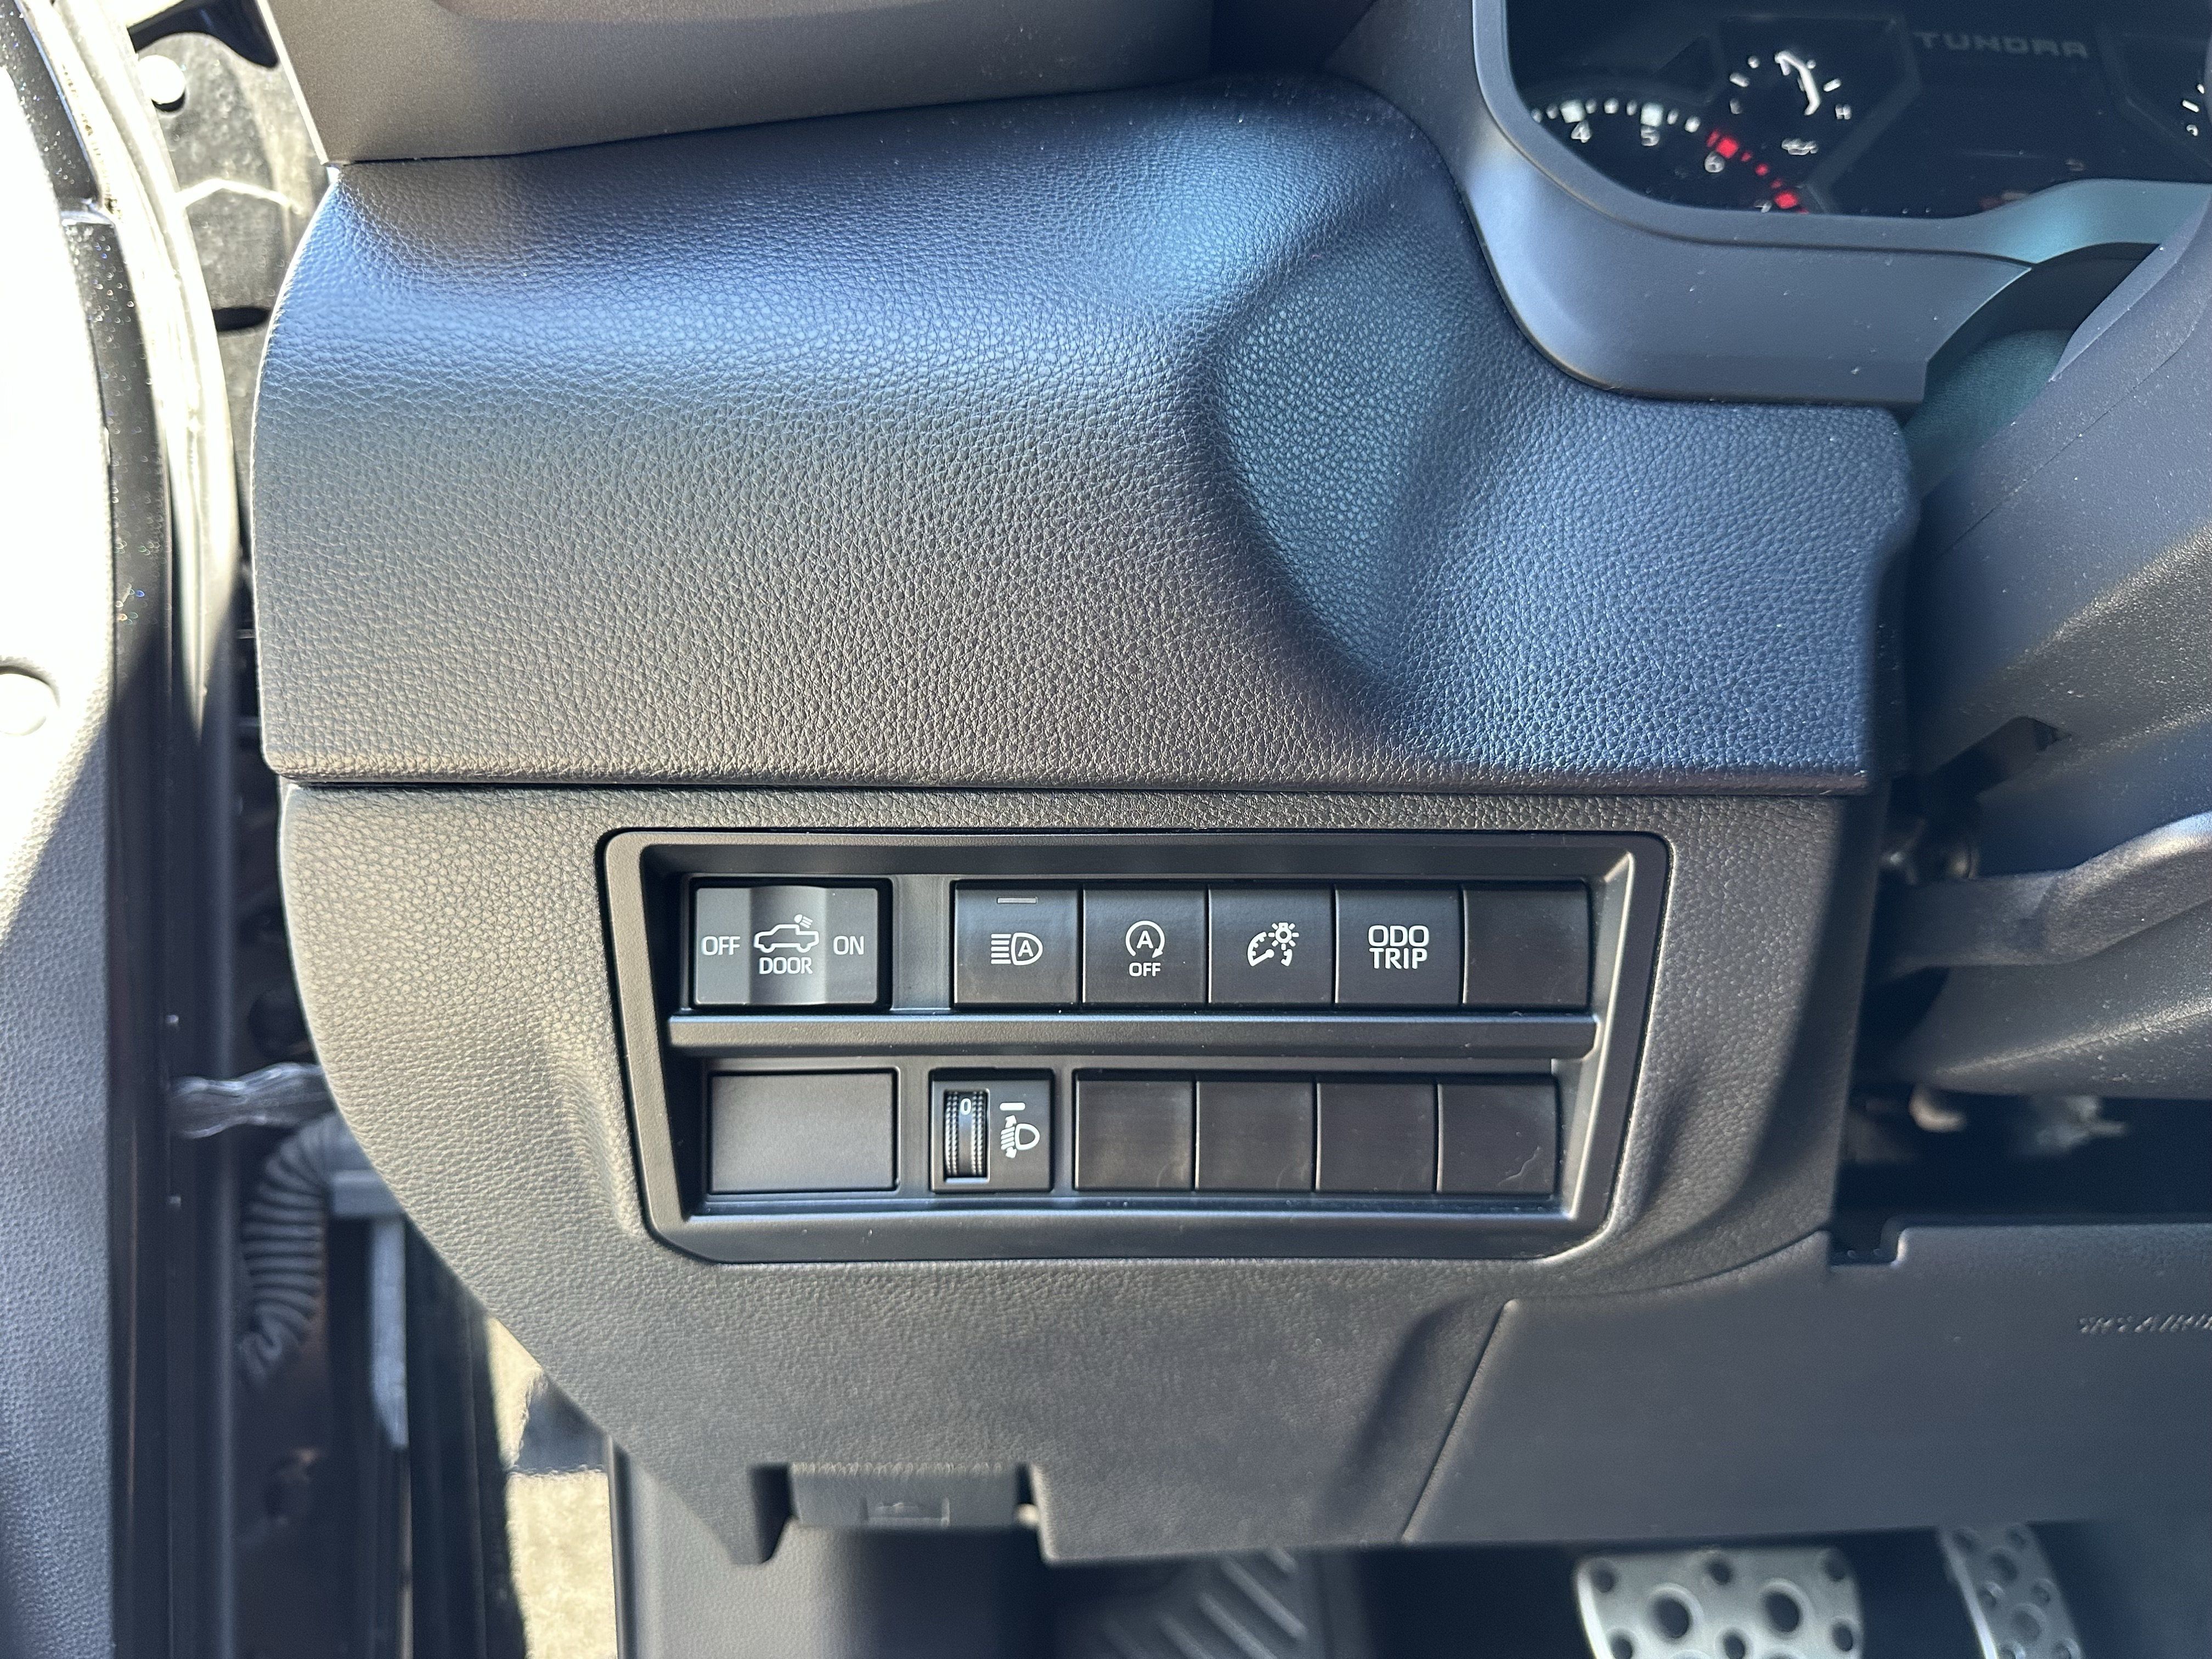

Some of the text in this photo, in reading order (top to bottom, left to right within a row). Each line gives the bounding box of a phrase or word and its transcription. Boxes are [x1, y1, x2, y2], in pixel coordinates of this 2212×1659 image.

[1914, 31, 2089, 59] TUNDRA
[1571, 120, 1592, 143] 4
[1640, 125, 1660, 147] 5
[1704, 151, 1725, 173] 6
[701, 935, 741, 956] OFF
[833, 935, 865, 955] ON
[1137, 930, 1154, 949] A
[1368, 925, 1430, 947] ODO
[1018, 940, 1034, 957] A
[1368, 947, 1428, 969] TRIP
[759, 957, 813, 975] DOOR
[1128, 962, 1161, 977] OFF
